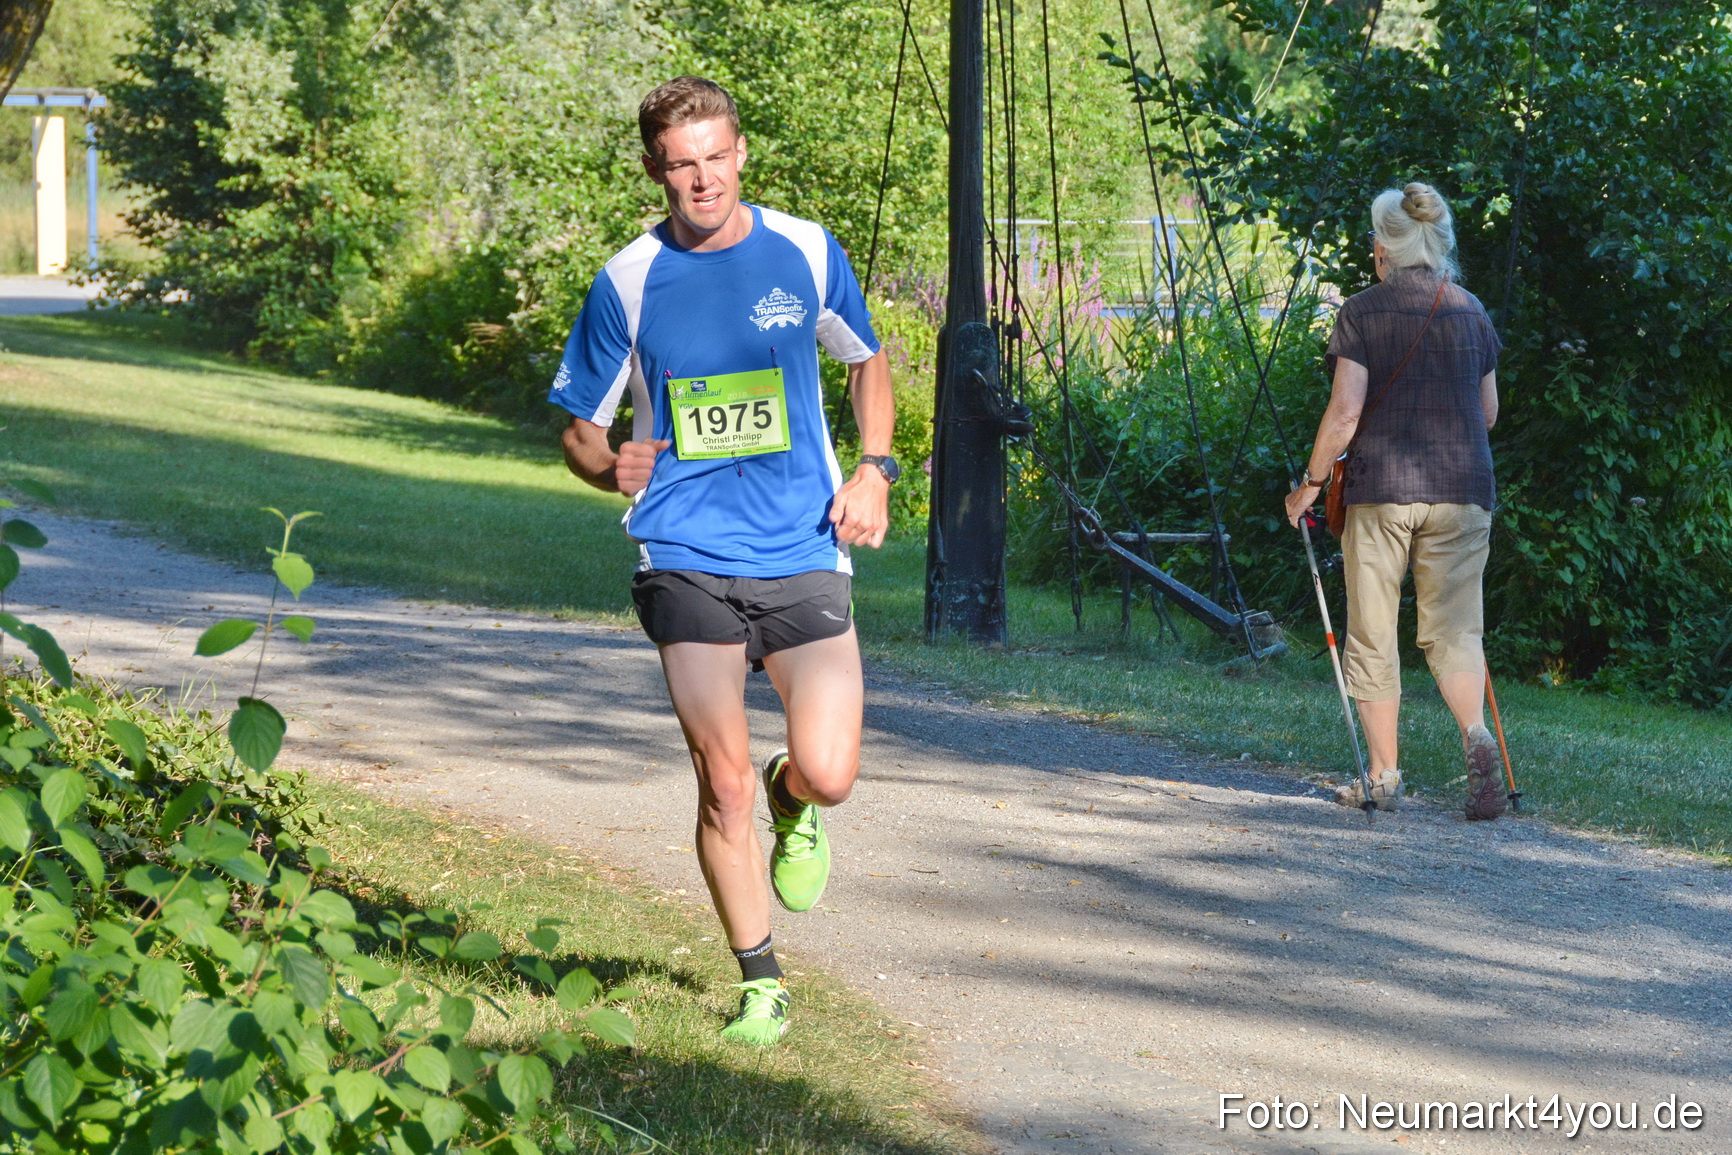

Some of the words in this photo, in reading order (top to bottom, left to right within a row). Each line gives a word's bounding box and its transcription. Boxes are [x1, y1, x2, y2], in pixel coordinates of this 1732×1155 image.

[754, 304, 803, 316] TRANSpofix
[688, 400, 772, 436] 1975
[702, 436, 730, 445] Christl
[732, 432, 763, 442] Philipp
[706, 443, 741, 451] TRANSpofix
[741, 440, 760, 448] GmbH
